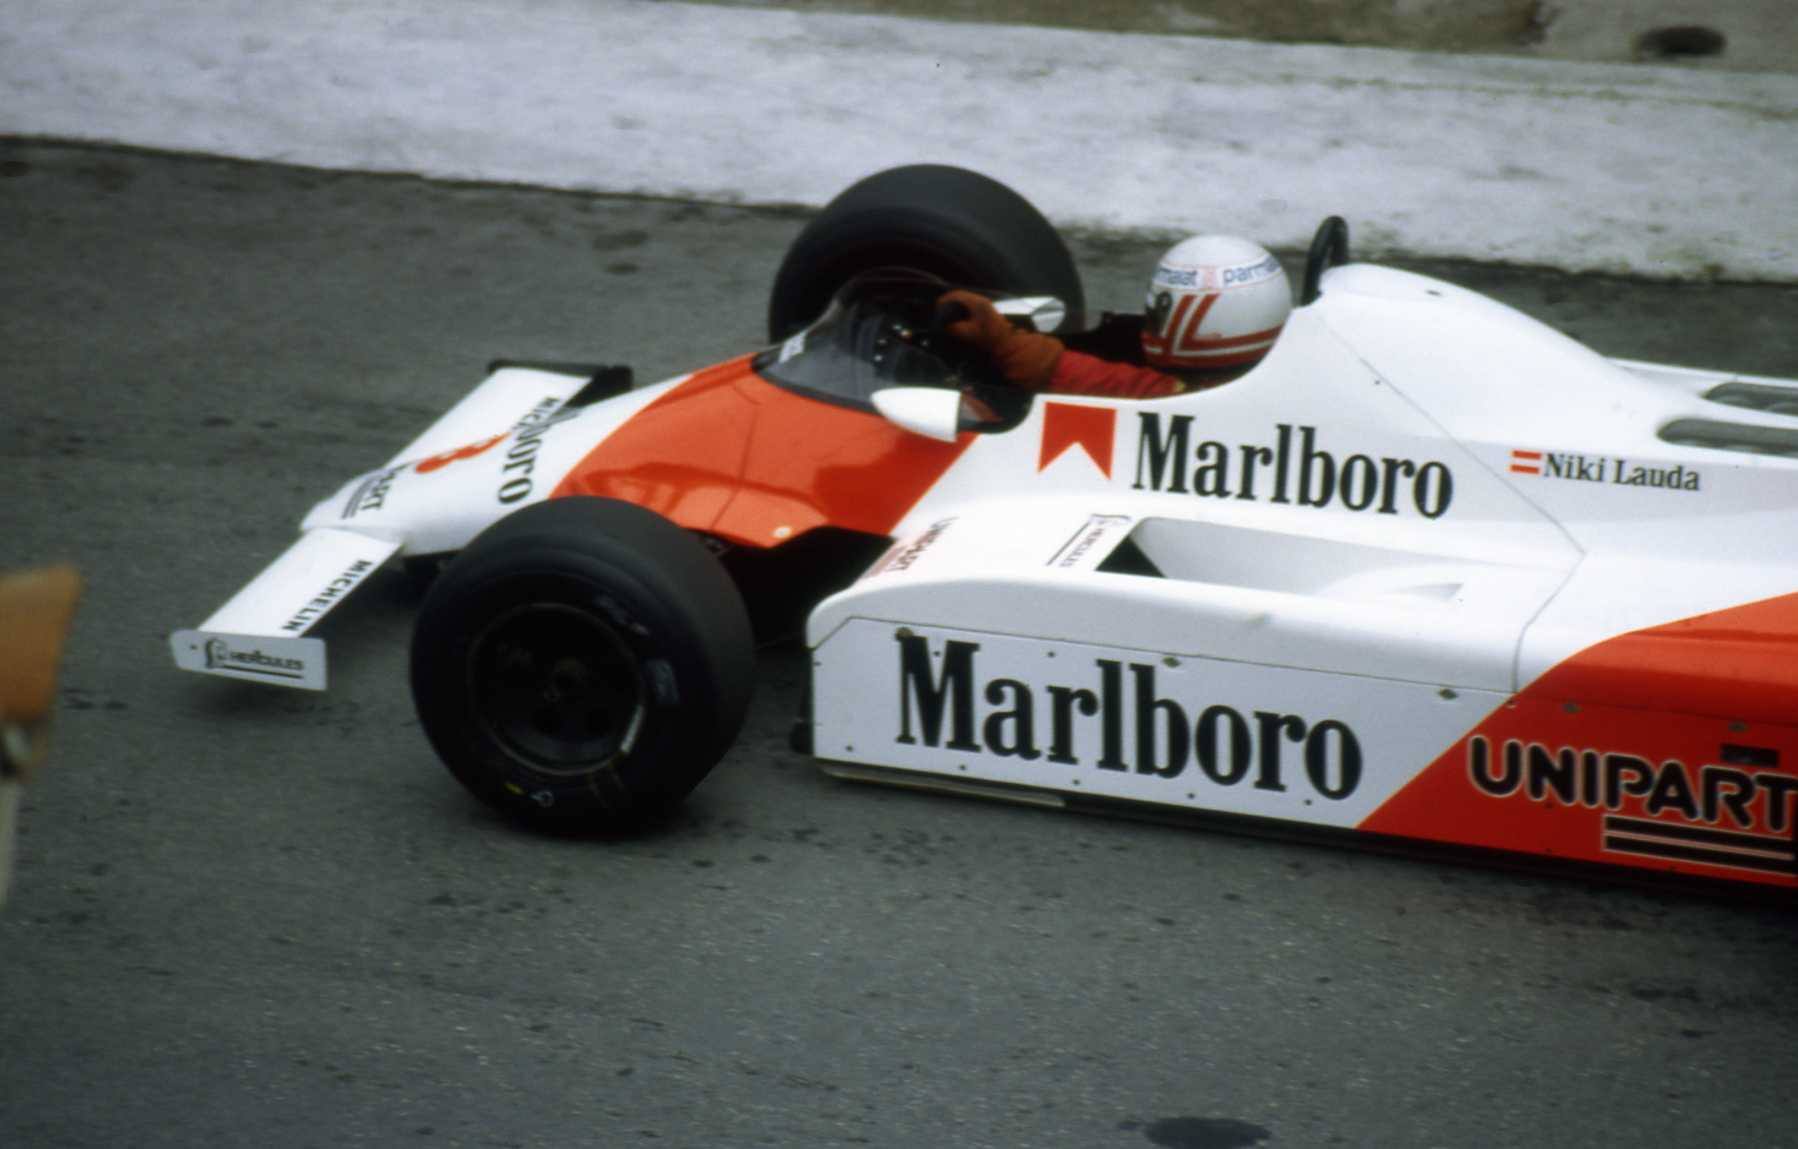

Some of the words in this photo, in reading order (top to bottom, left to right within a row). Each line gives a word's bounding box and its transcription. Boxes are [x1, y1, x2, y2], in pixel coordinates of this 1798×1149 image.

[1131, 411, 1455, 519] Marlboro
[1544, 453, 1605, 482] Niki
[1612, 459, 1700, 491] Lauda
[281, 560, 373, 632] MICHELIN
[895, 634, 1363, 800] Marlboro
[1467, 734, 1798, 833] UNIPART
